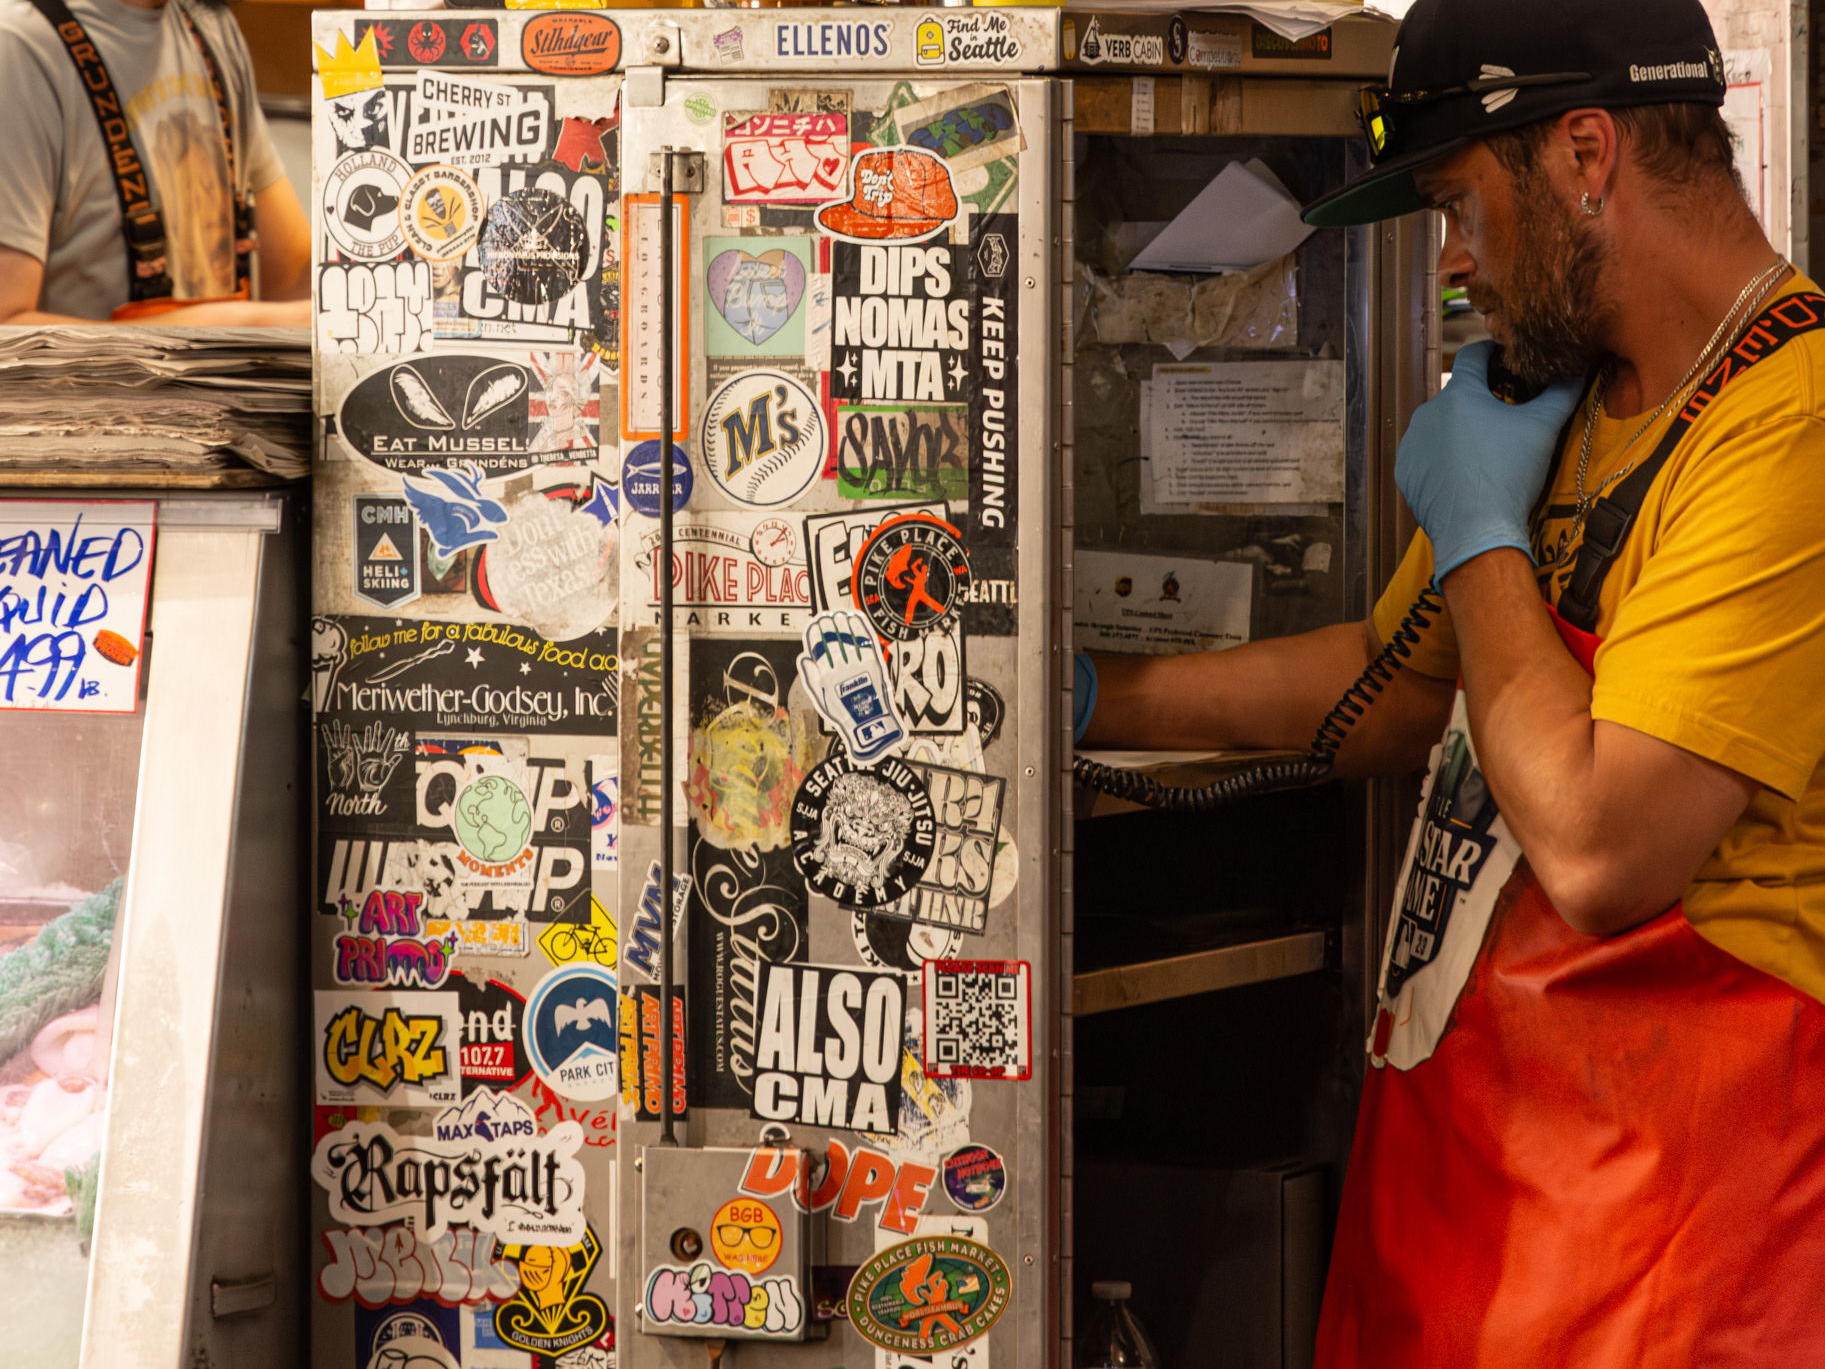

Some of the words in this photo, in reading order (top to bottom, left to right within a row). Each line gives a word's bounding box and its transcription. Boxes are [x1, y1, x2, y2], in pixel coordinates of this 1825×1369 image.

[947, 19, 980, 33] Find
[983, 16, 1007, 32] Me
[777, 24, 889, 56] ELLENOS
[950, 33, 1018, 61] Seattle
[1106, 39, 1131, 58] VERB
[1133, 38, 1162, 60] CABIN
[1630, 60, 1708, 82] Generational
[423, 78, 492, 109] CHERRY
[497, 92, 511, 107] ST
[413, 109, 540, 155] BREWING
[335, 154, 397, 182] HOLLAND
[451, 154, 467, 165] EST.
[469, 153, 490, 164] 2012
[861, 169, 893, 189] Don't
[863, 187, 893, 207] Trip
[351, 241, 374, 256] THE
[379, 234, 400, 255] PUP
[859, 245, 951, 298] DIPS
[834, 296, 970, 351] NOMAS
[981, 296, 1005, 380] KEEP
[861, 349, 946, 401] MTA
[373, 435, 417, 451] EAT
[428, 435, 529, 452] MUSSEL
[721, 383, 800, 482] M's
[981, 388, 1006, 529] PUSHING
[361, 506, 408, 524] CMH
[678, 528, 740, 546] CENTENNIAL
[363, 565, 400, 577] HELI
[864, 539, 893, 586] PIKE
[900, 527, 960, 561] PLACE
[363, 578, 410, 589] SKIING
[873, 607, 909, 640] FISH
[351, 633, 390, 660] follow
[394, 625, 417, 644] me
[420, 621, 443, 643] for
[446, 626, 460, 639] a
[462, 622, 539, 655] fabulous
[536, 640, 591, 668] food
[839, 676, 868, 696] franklin
[337, 682, 568, 721] Meriwether-Godsey,
[575, 687, 613, 718] Inc.
[436, 713, 499, 728] Lynchburg,
[502, 712, 547, 726] Virginia
[394, 732, 411, 750] th
[326, 791, 388, 817] North
[456, 847, 534, 878] MOMENTS
[792, 827, 907, 904] ACADEMY
[359, 890, 424, 936] ART
[335, 935, 452, 983] PRIMO
[756, 966, 902, 1084] ALSO
[324, 1006, 448, 1093] CLRZ
[560, 1065, 591, 1082] PARK
[754, 1072, 896, 1134] C.M.A.
[437, 1124, 473, 1140] MAX
[493, 1120, 533, 1137] TAPS
[730, 1206, 764, 1223] BGB
[854, 1272, 875, 1302] PIKE
[873, 1245, 913, 1274] PLACE
[916, 1240, 945, 1253] FISH
[950, 1242, 999, 1273] MARKET
[859, 1315, 935, 1350] DUNGENESS
[939, 1325, 975, 1347] CRAB
[975, 1287, 1006, 1328] CAKES
[511, 1331, 551, 1348] GOLDEN
[552, 1326, 593, 1347] KNIGHTS
